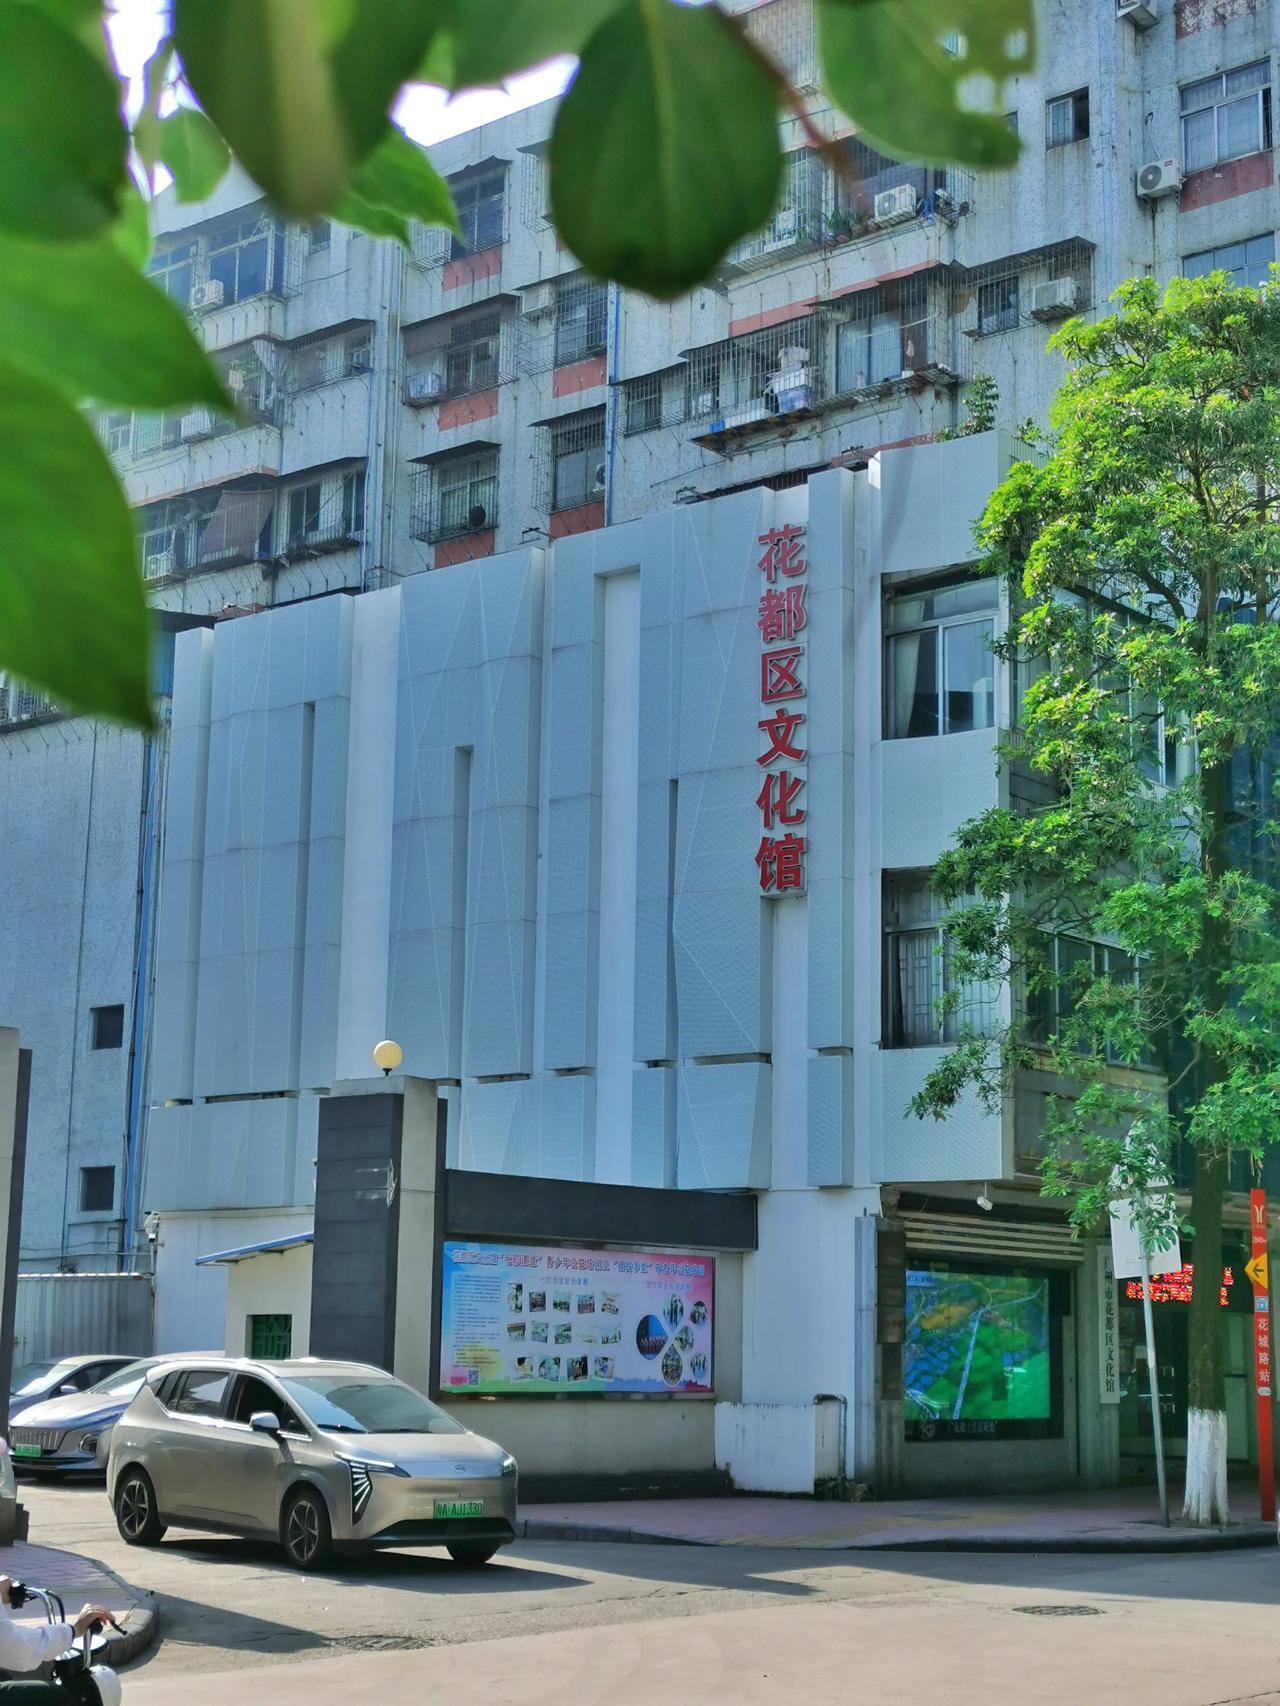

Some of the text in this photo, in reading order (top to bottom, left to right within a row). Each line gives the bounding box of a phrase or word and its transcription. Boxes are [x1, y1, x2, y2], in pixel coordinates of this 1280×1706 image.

[755, 523, 807, 891] 花都区文化馆
[1103, 1255, 1115, 1393] 广州市花都区文化馆
[1258, 1318, 1270, 1382] 花城路站
